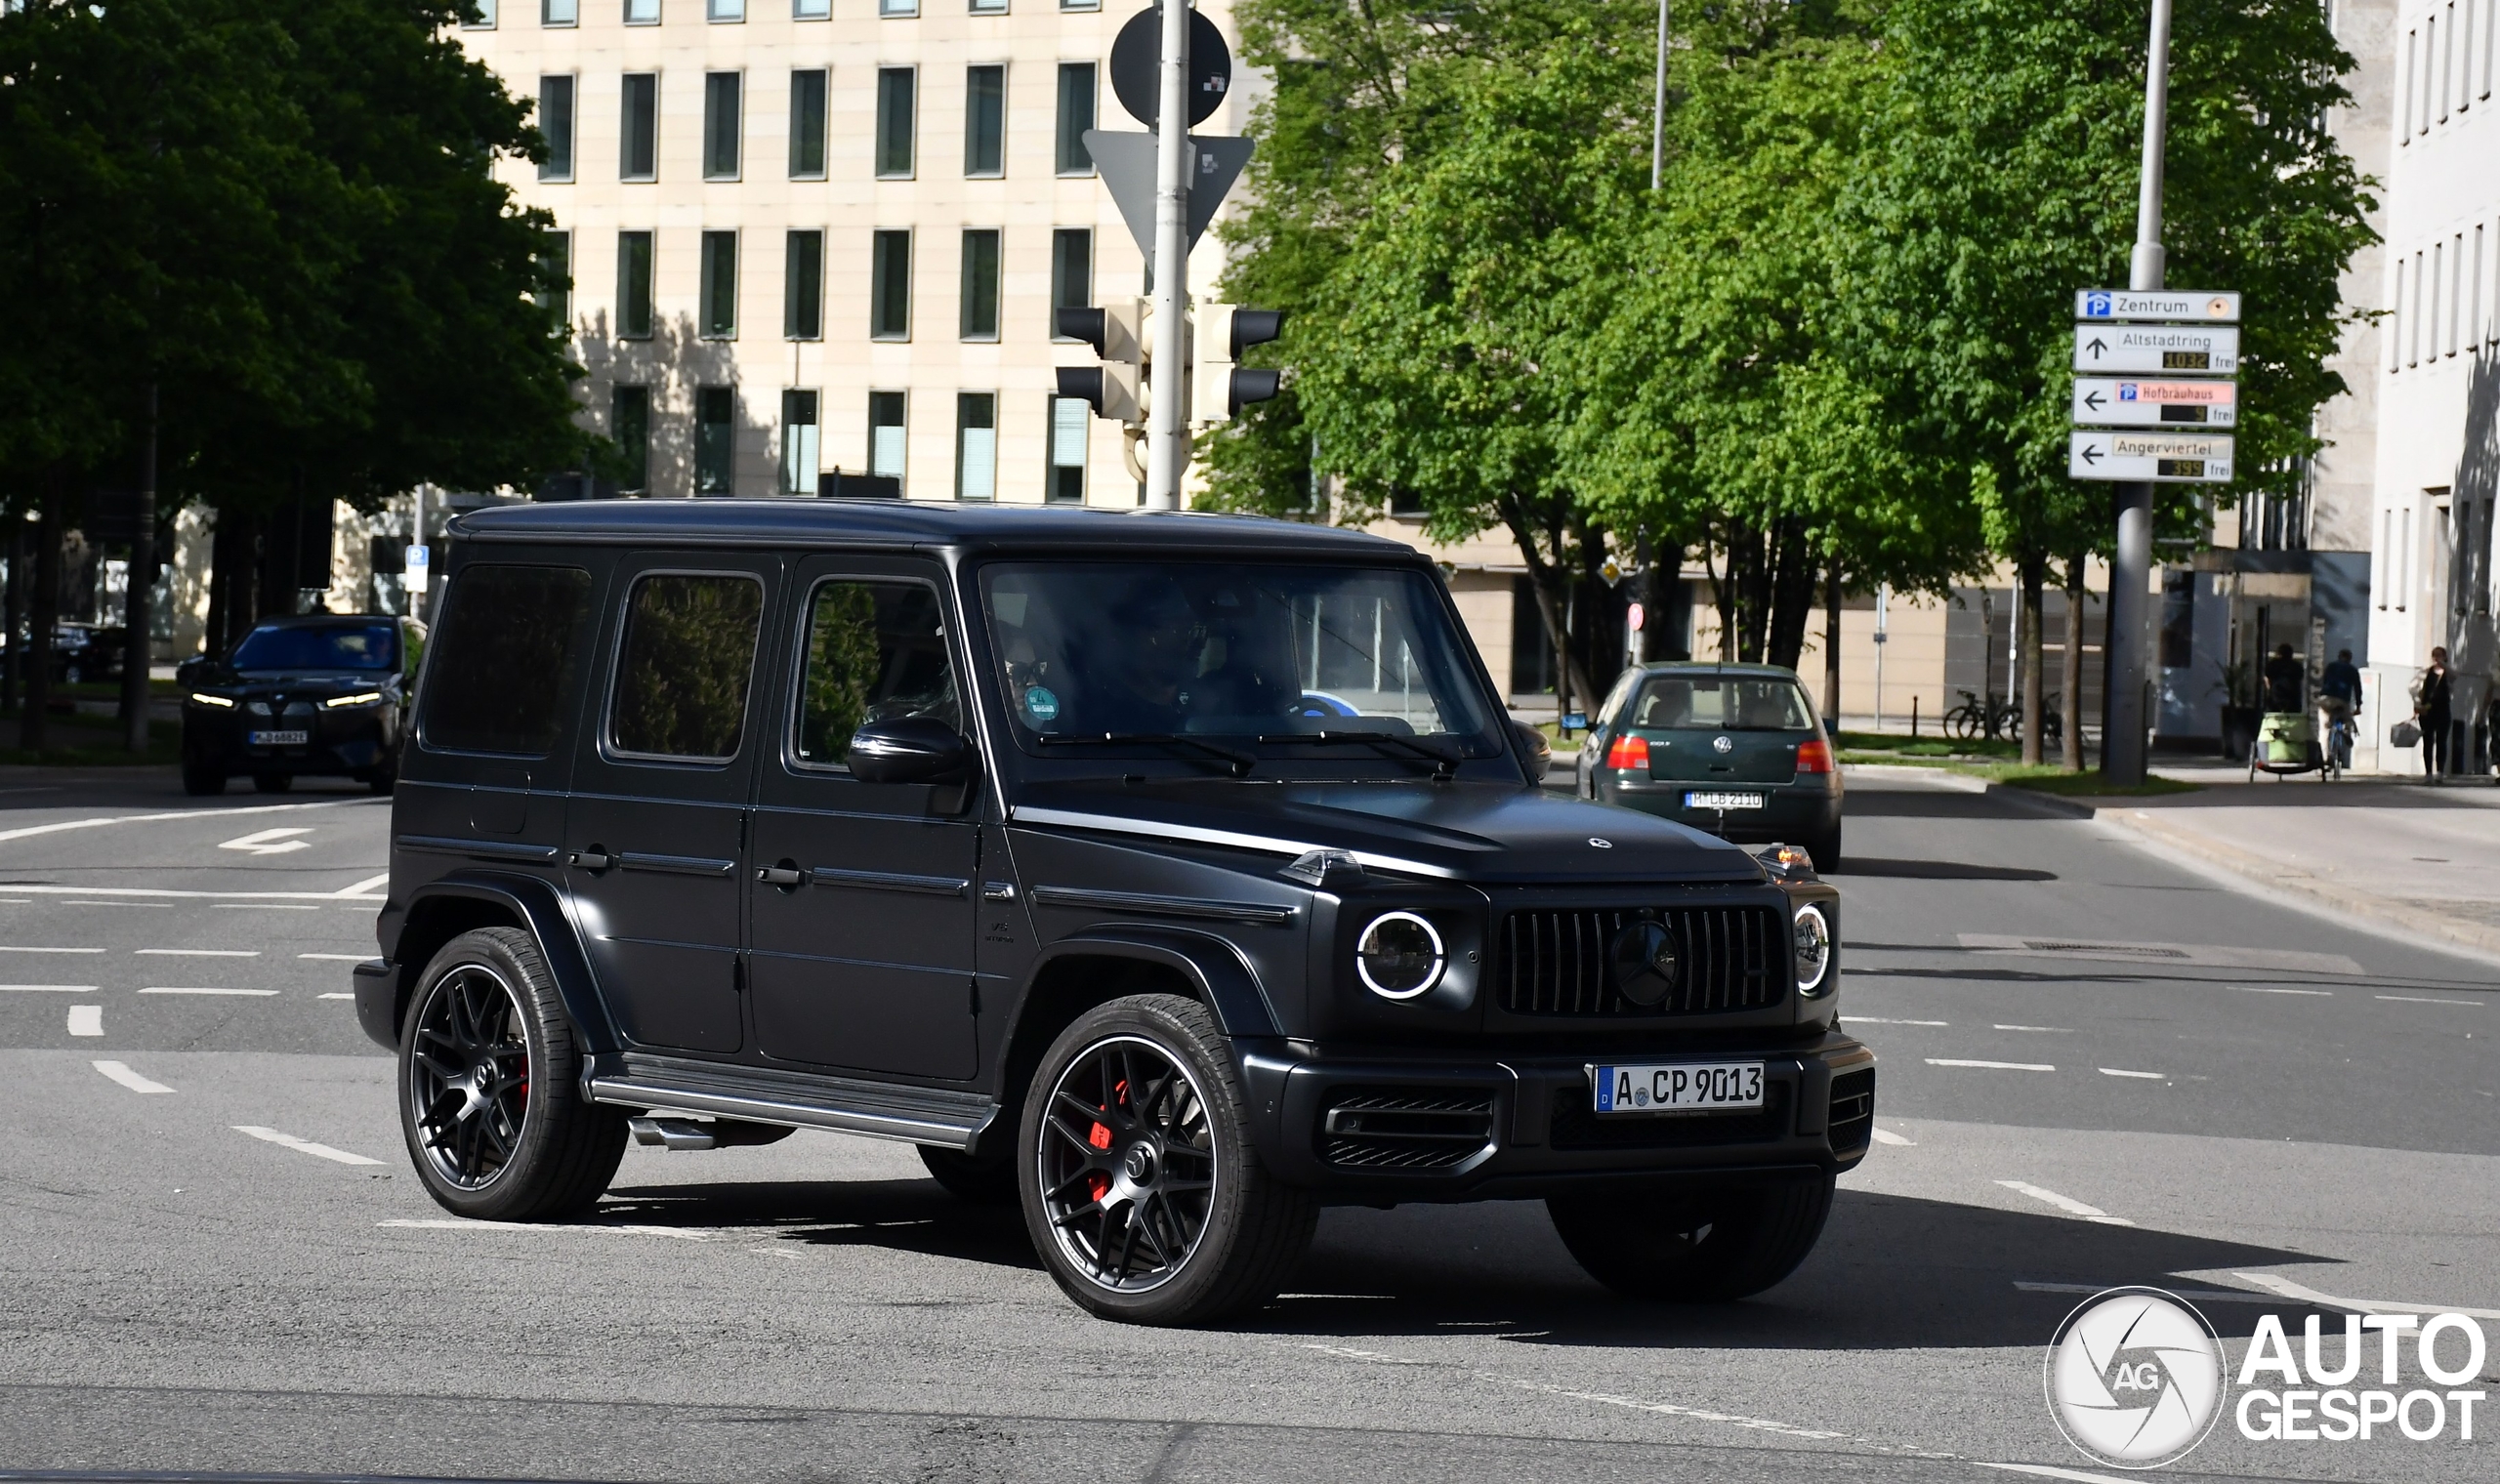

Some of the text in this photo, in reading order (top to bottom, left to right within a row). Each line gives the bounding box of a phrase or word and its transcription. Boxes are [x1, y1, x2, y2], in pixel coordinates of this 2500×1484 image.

[2118, 298, 2188, 313] Zentrum
[2123, 333, 2212, 351] Altstadtring
[2165, 352, 2235, 368] 1032 frei
[2143, 386, 2214, 400] Hofbräuhaus
[2213, 408, 2232, 421] frei
[2117, 440, 2212, 457] Angerviertel
[2173, 461, 2229, 476] 399 frei
[1693, 792, 1761, 805] M LB 2110
[1616, 1067, 1761, 1105] A CP 9013
